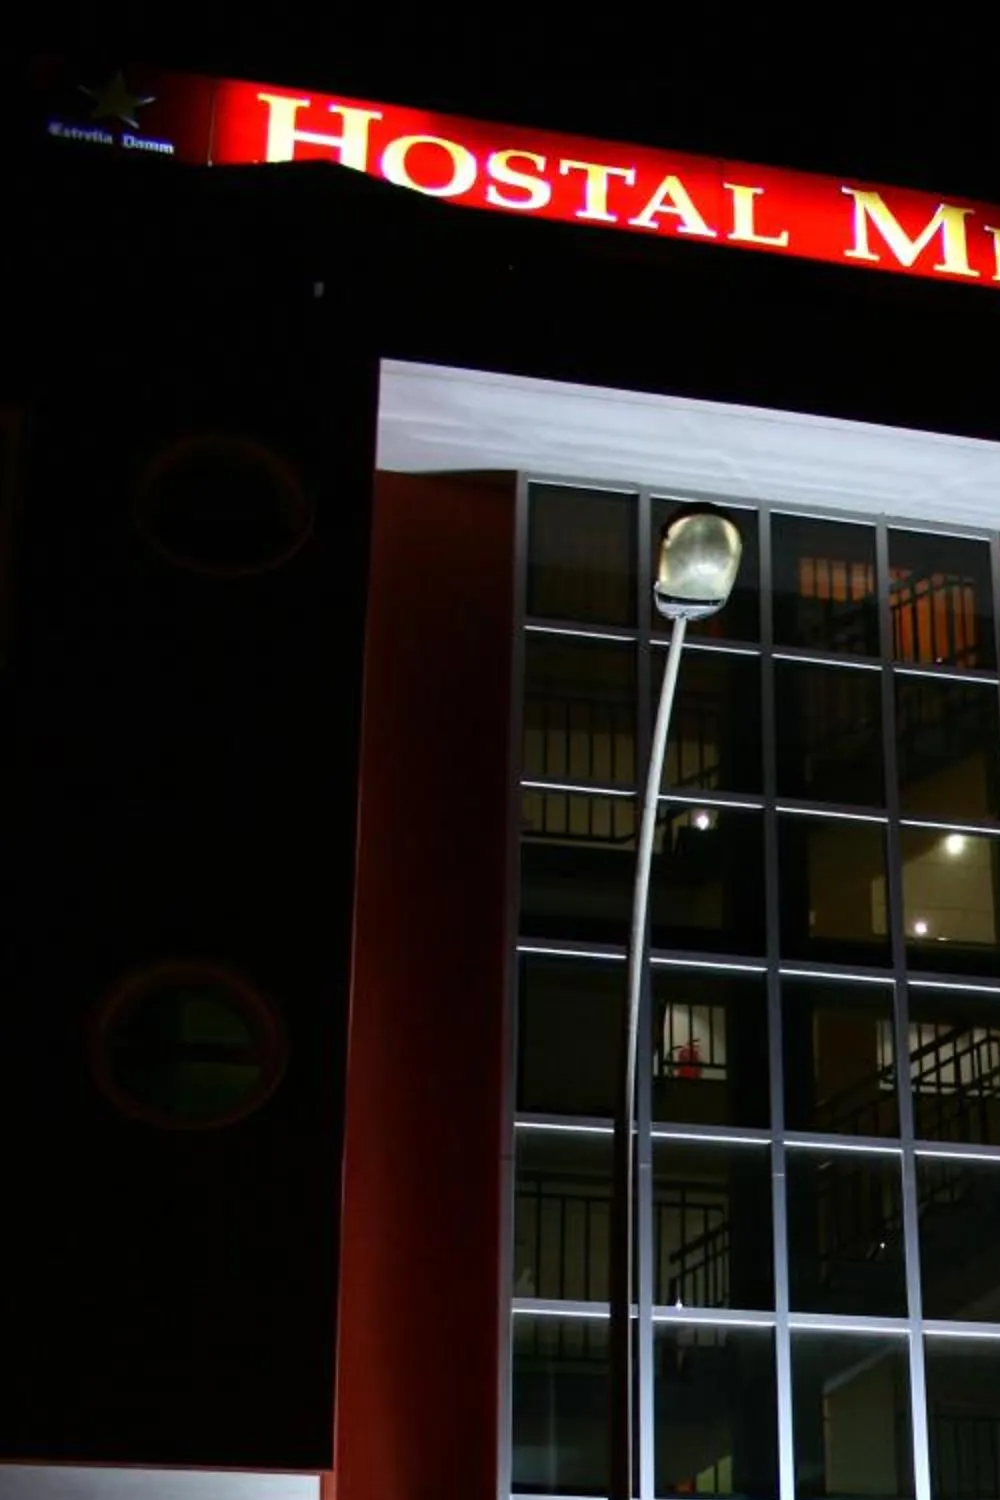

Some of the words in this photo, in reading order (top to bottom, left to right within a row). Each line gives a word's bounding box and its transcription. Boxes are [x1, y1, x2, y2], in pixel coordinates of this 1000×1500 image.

[47, 120, 114, 146] Estrella
[122, 133, 175, 156] Damm
[257, 92, 790, 248] HOSTAL
